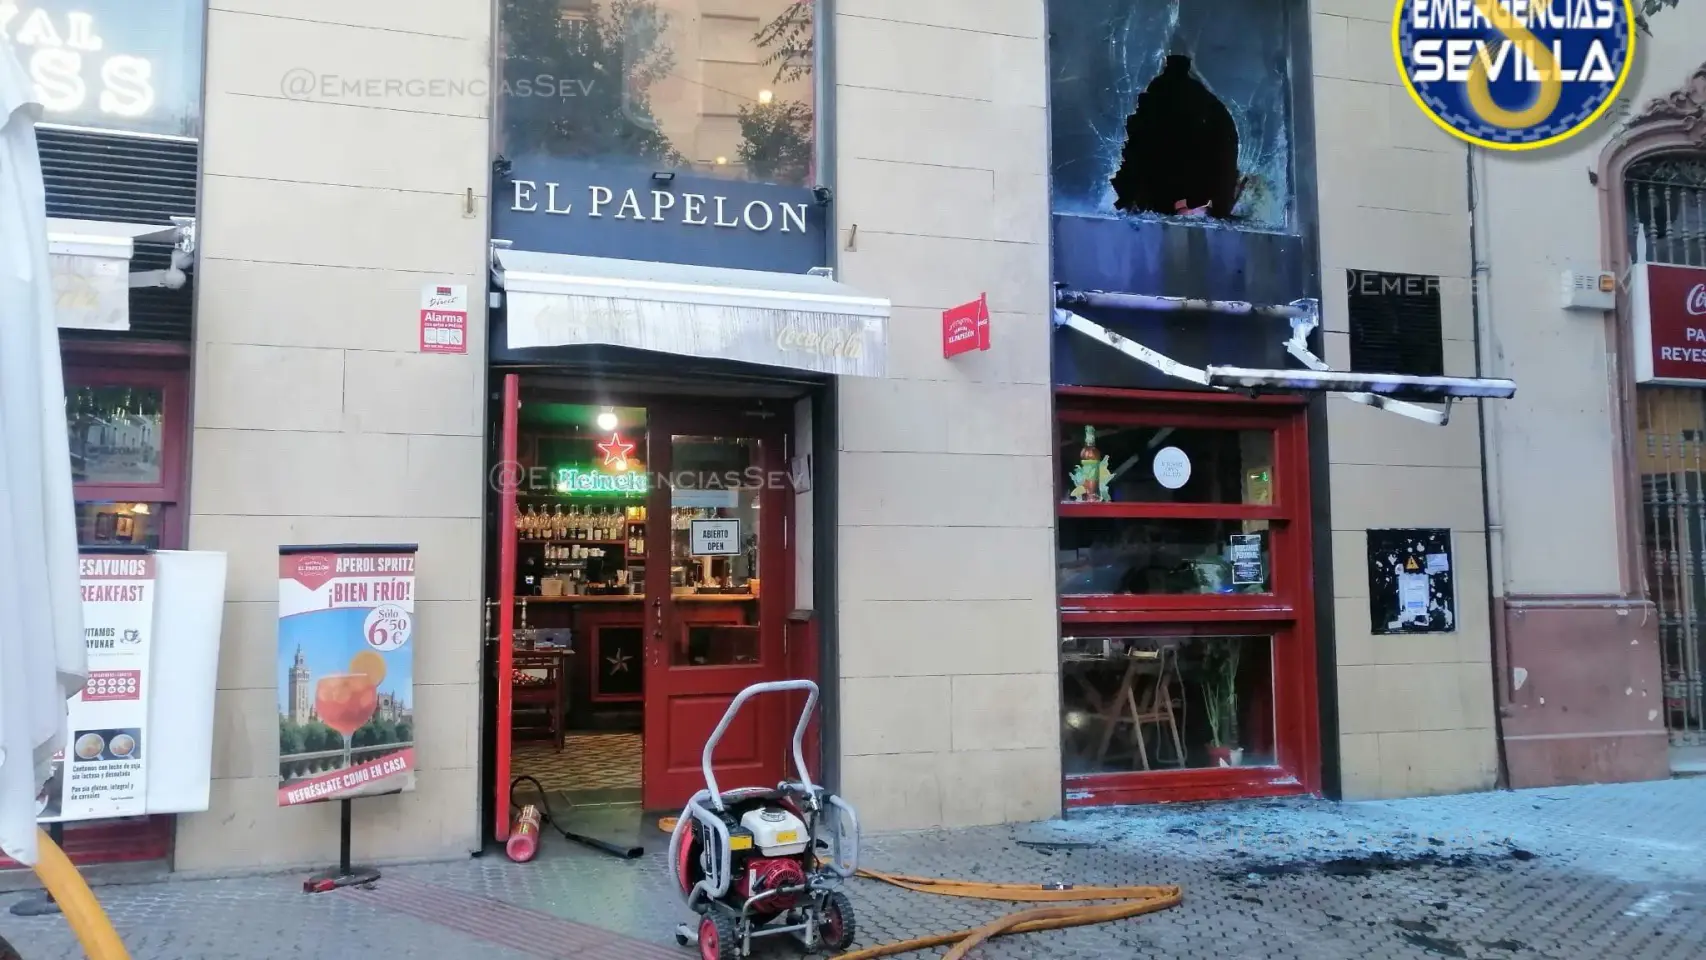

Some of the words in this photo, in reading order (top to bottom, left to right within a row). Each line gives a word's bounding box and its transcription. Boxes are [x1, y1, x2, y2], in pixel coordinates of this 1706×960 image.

[510, 179, 572, 215] EL
[588, 185, 809, 233] PAPELON
[425, 312, 463, 323] Alarma
[702, 530, 729, 538] ABIERTO
[707, 542, 724, 550] OPEN
[80, 559, 146, 576] ESAYUNOS
[335, 557, 375, 572] APEROL
[378, 557, 414, 571] SPRITZ
[80, 585, 144, 602] REAKFAST
[329, 582, 368, 607] ¡BIEN
[373, 578, 410, 601] FRÍO!
[378, 609, 399, 619] Sólo
[287, 777, 342, 804] REFRÉSCATE
[343, 768, 369, 787] COMO
[371, 762, 382, 778] EN
[384, 757, 407, 774] CASA
